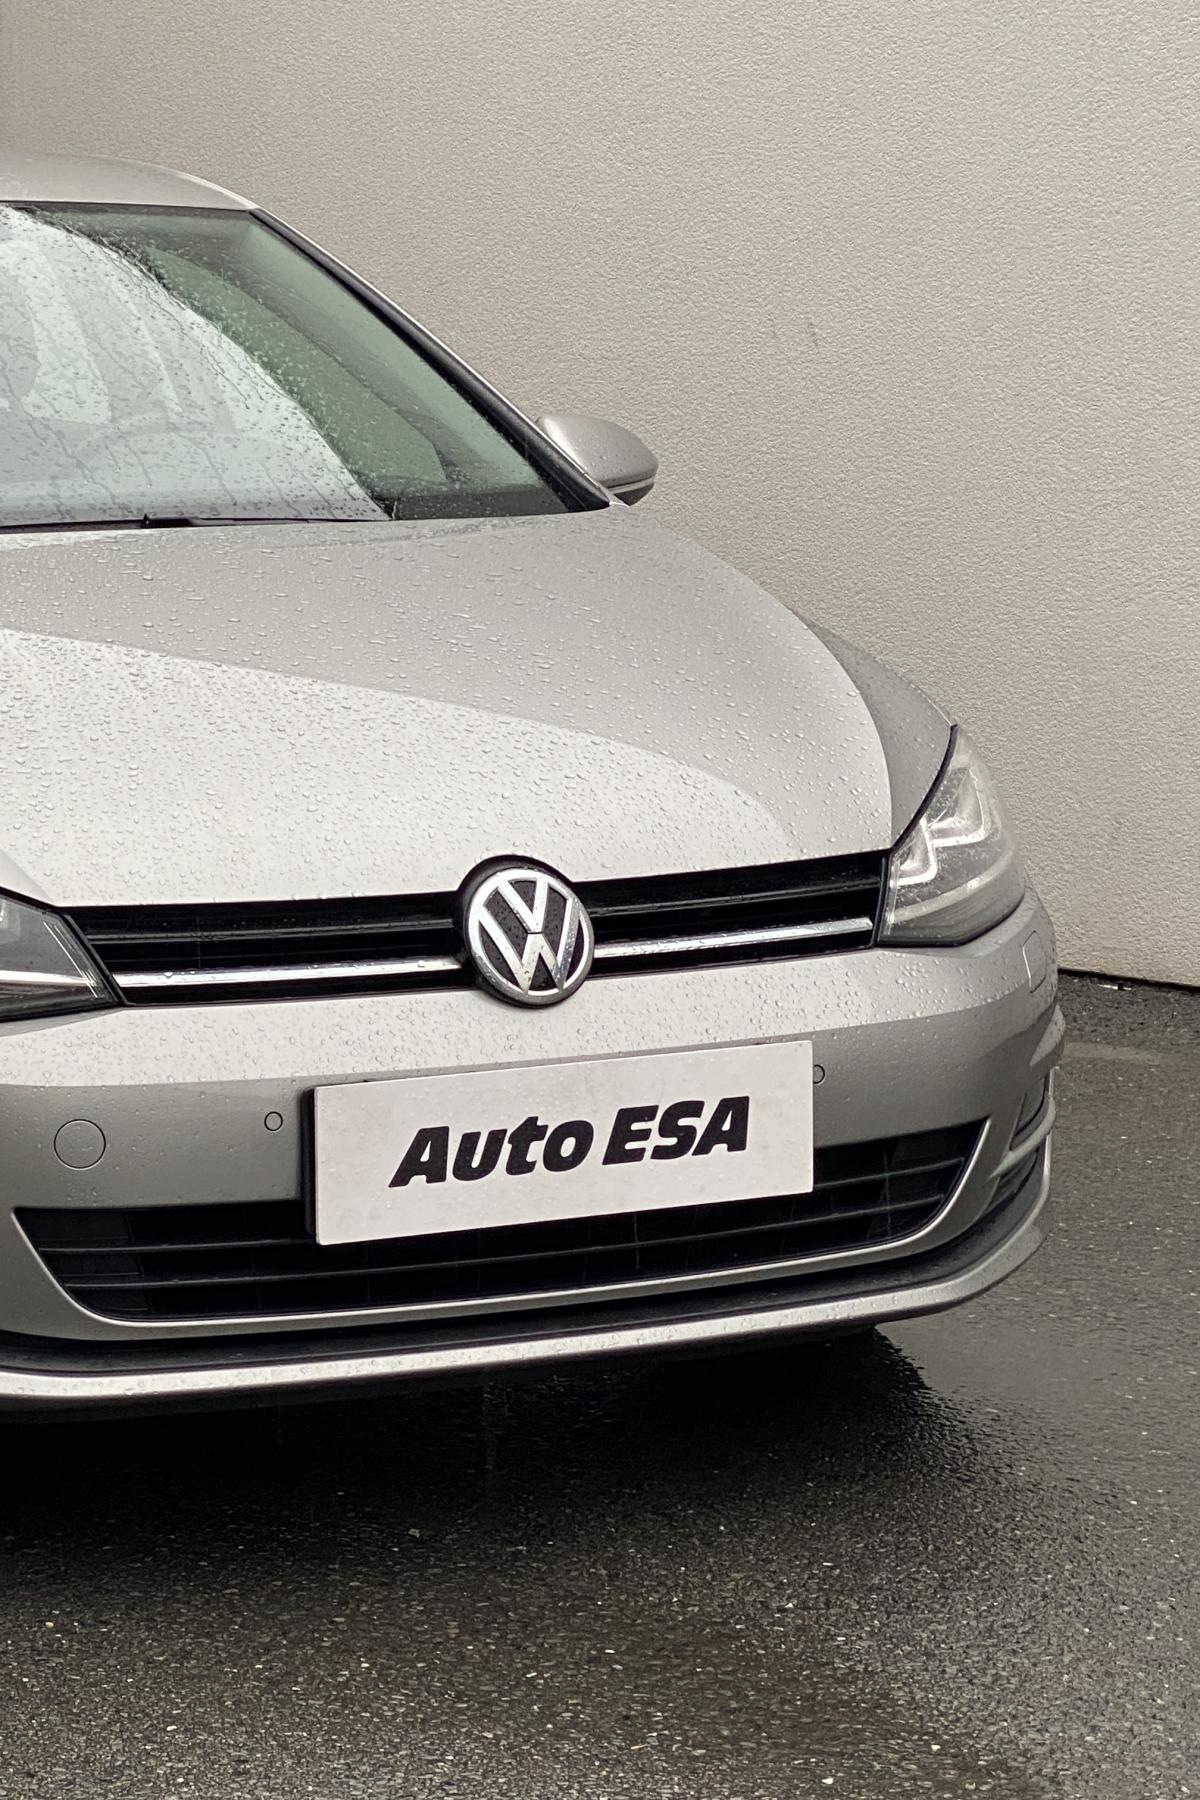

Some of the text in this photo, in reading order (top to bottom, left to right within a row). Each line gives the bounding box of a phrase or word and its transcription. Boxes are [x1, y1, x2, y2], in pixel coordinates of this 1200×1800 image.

[471, 869, 589, 1000] VW
[388, 1095, 750, 1188] Auto ESA
